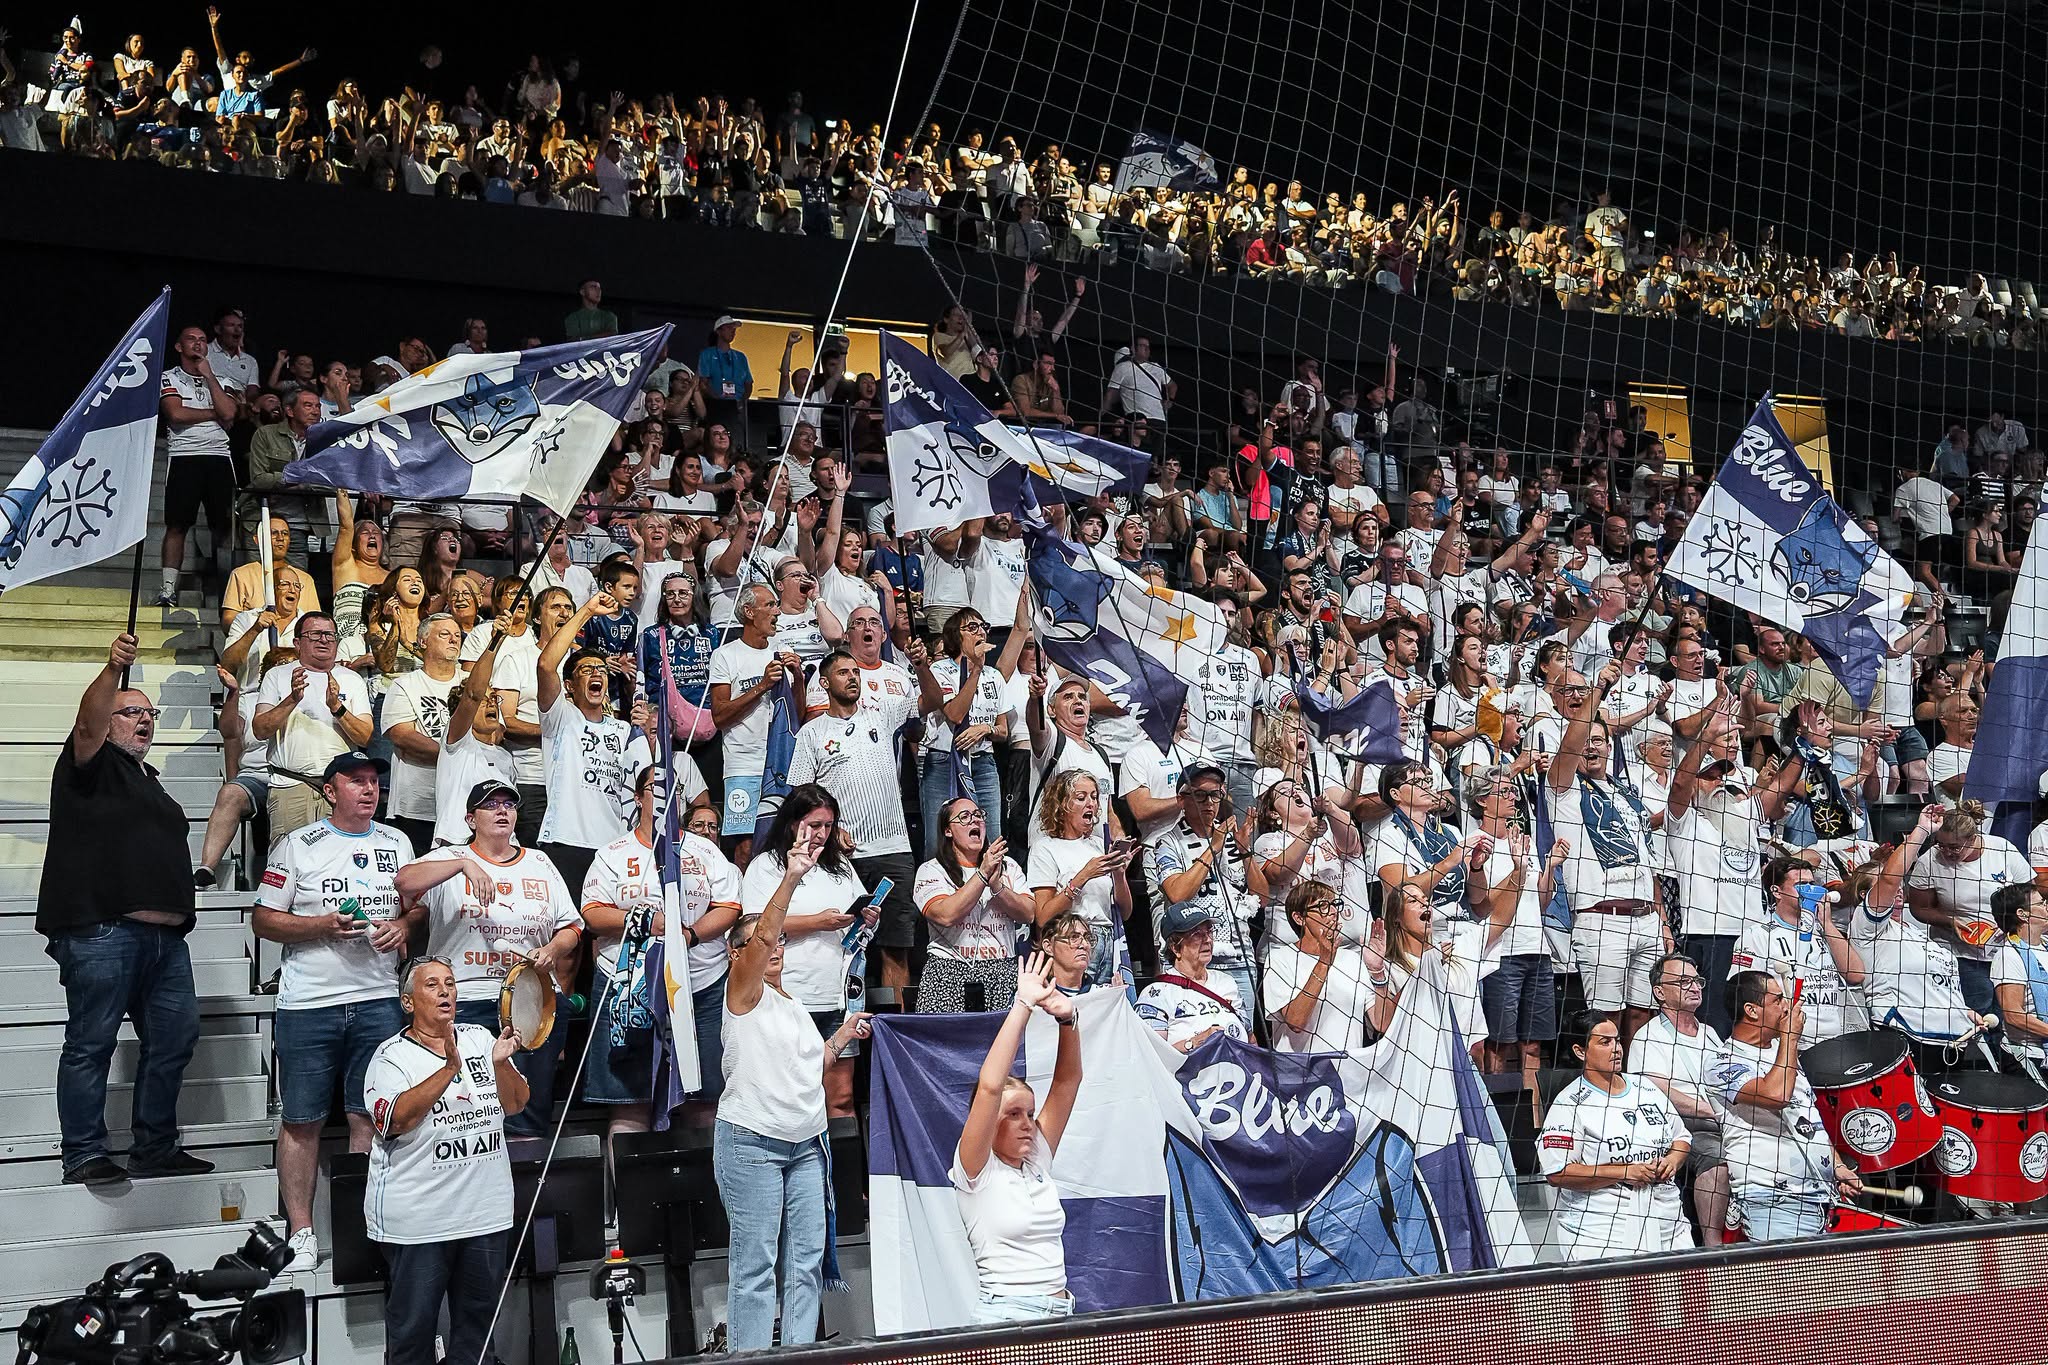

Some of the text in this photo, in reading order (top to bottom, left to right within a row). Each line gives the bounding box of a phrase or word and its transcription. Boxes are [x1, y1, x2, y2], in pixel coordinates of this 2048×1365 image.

[1733, 424, 1810, 502] Blue
[1206, 710, 1227, 721] ON
[377, 863, 395, 873] BS
[627, 857, 640, 877] 5
[321, 878, 349, 894] FDi
[620, 884, 649, 901] FDi
[523, 891, 545, 901] BS
[460, 904, 490, 919] FDi
[469, 923, 542, 936] Montpellier
[1776, 937, 1792, 956] 11
[431, 1096, 449, 1115] Di
[1189, 1061, 1342, 1143] Blue
[433, 1104, 503, 1127] Montpellier
[435, 1132, 501, 1160] ON AIR
[1607, 1134, 1632, 1152] FDi
